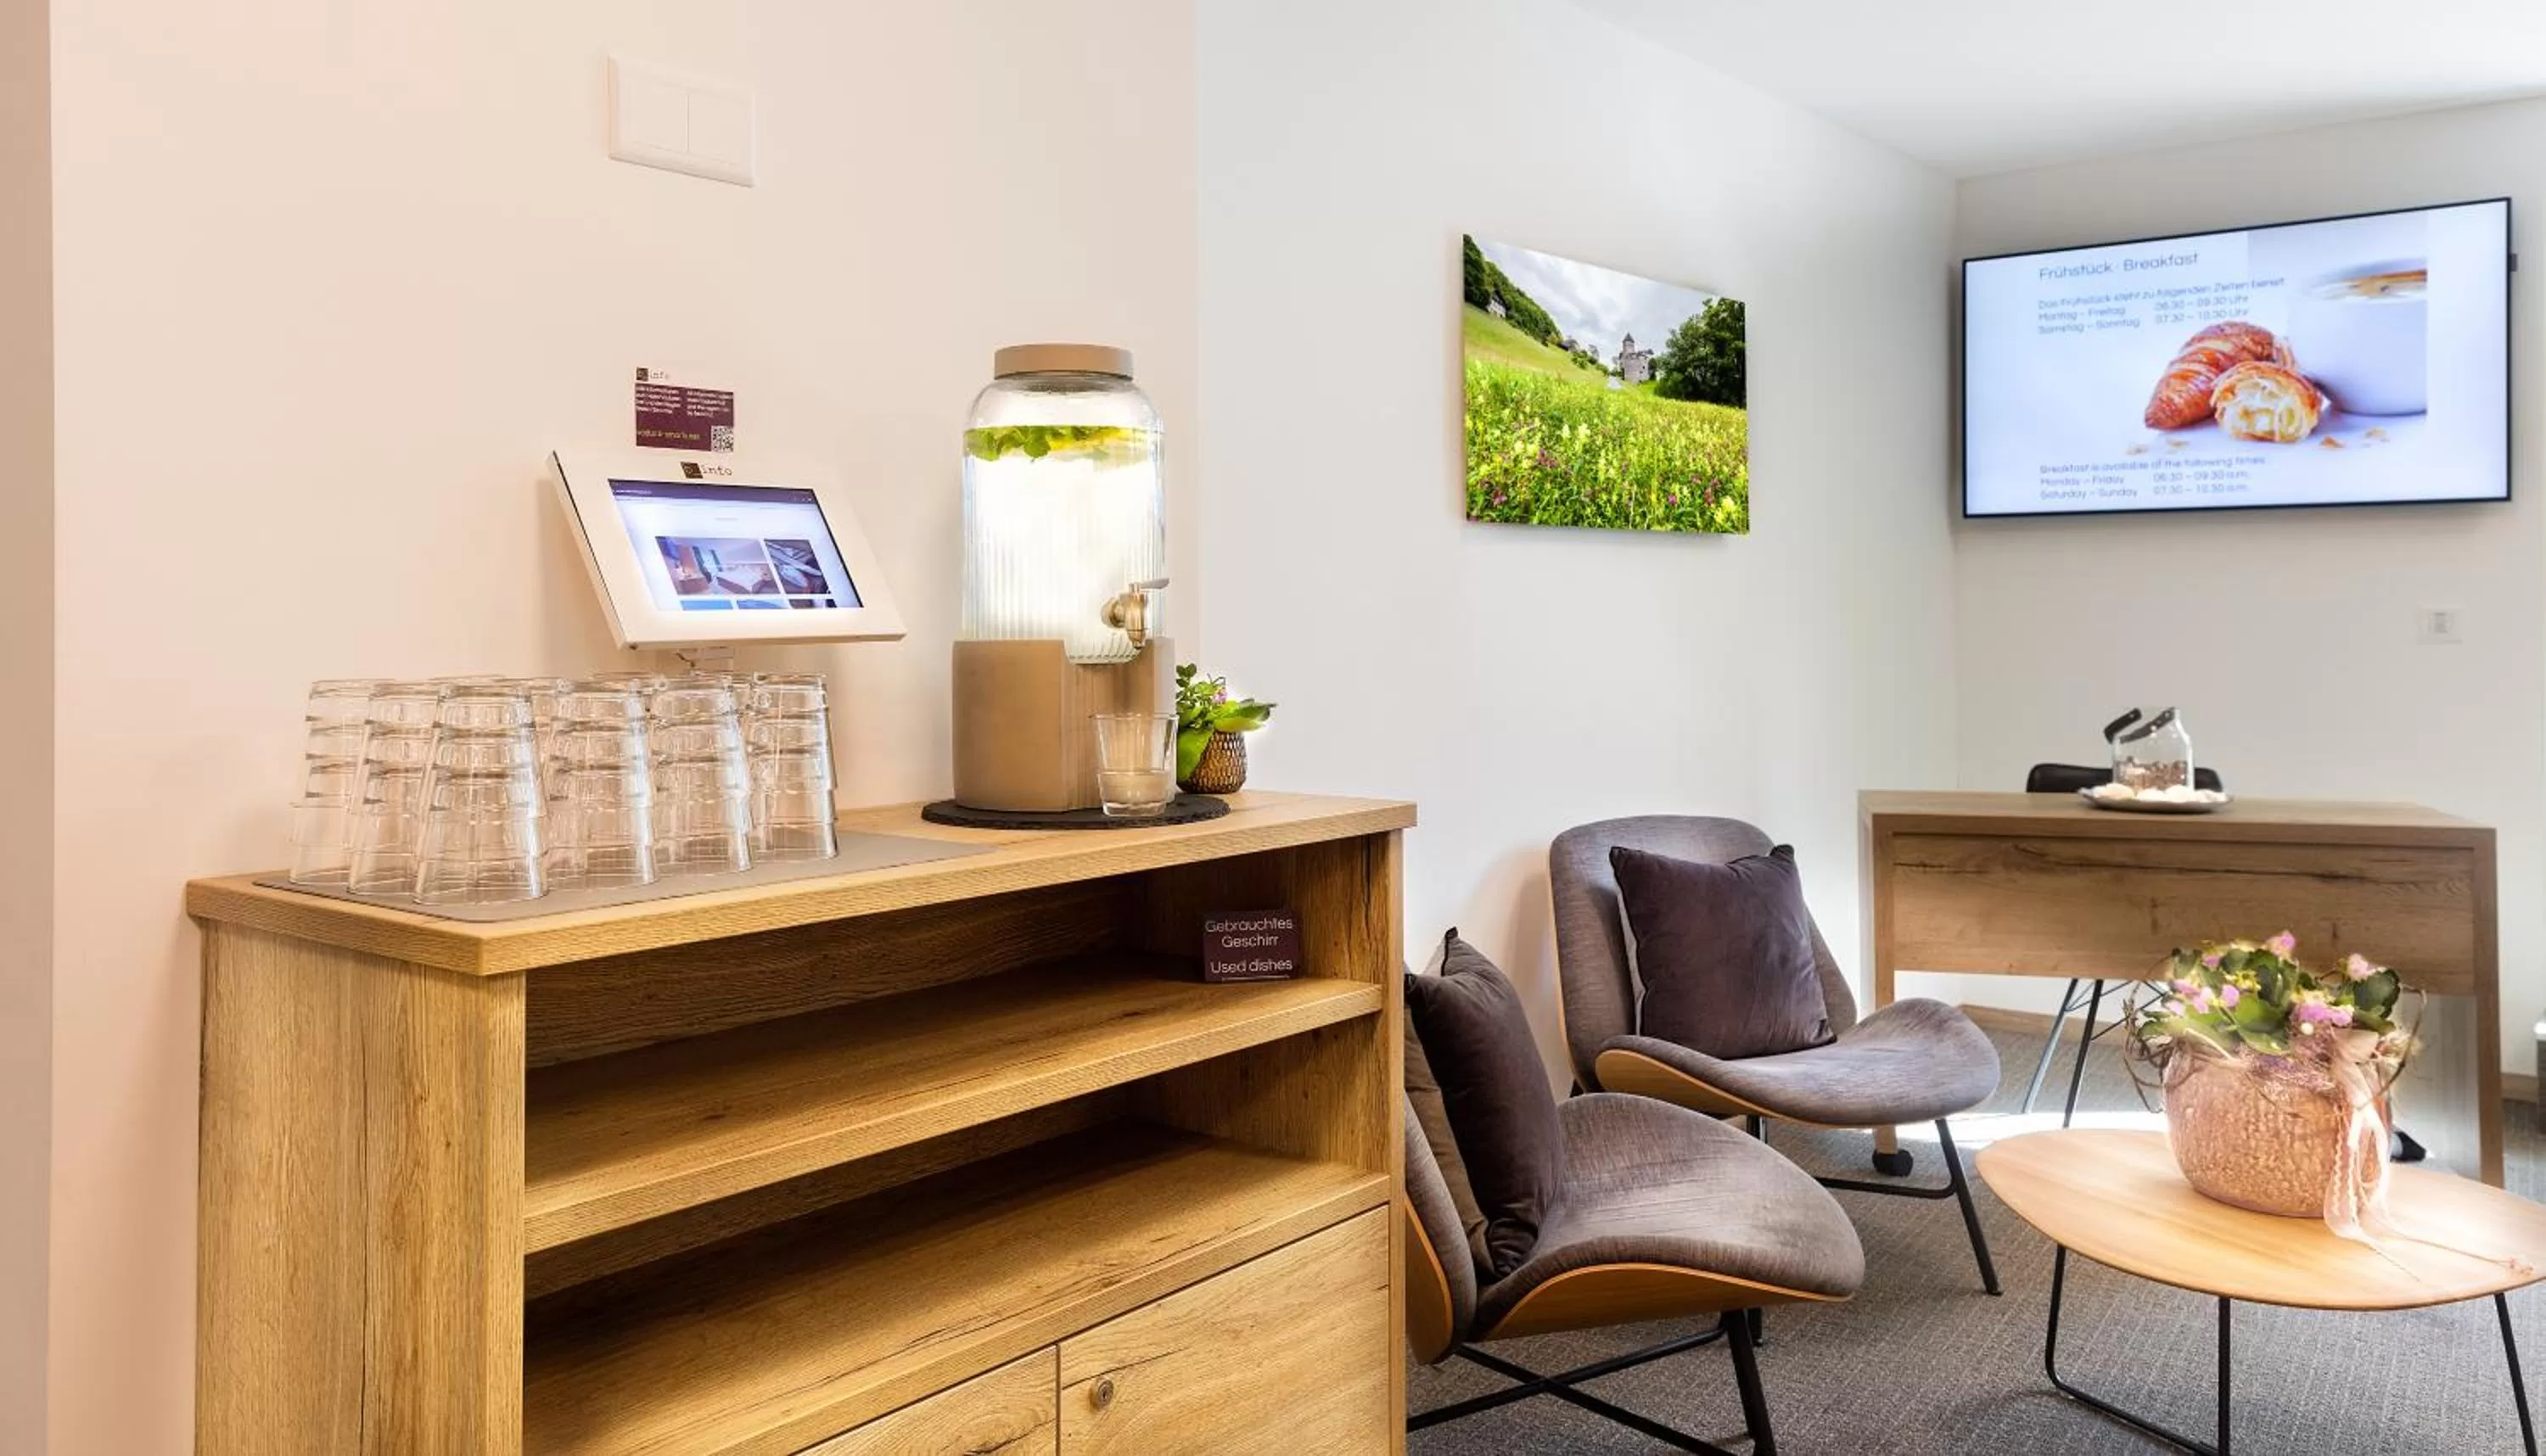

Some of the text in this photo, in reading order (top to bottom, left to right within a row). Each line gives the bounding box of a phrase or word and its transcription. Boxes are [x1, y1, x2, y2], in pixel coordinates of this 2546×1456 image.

[2038, 253, 2198, 280] Frühstück Breakfast
[2038, 311, 2078, 322] Montag
[1205, 918, 1293, 932] Gebrauchtes
[1221, 934, 1280, 949] Geschirr
[1209, 958, 1293, 973] Used dishes
